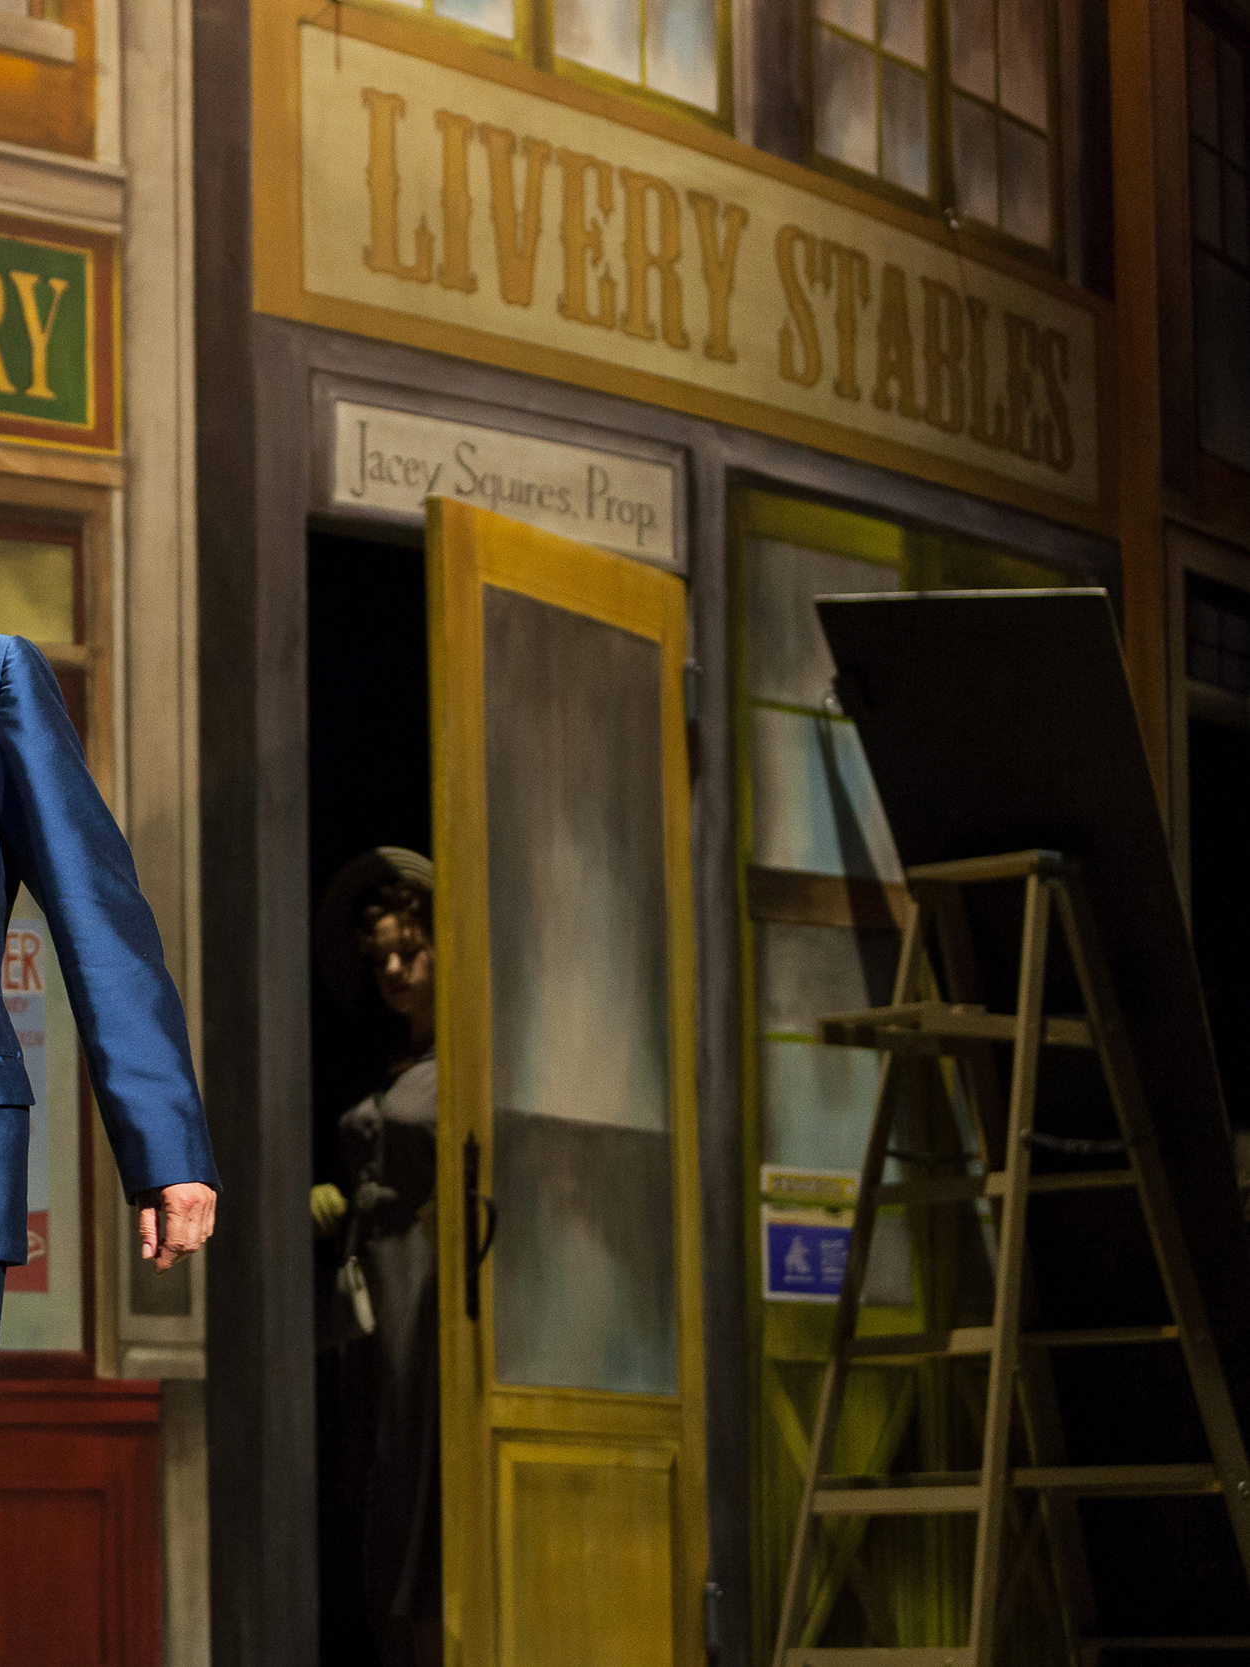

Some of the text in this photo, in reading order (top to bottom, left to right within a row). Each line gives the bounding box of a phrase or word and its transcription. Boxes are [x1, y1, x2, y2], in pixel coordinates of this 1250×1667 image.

[361, 87, 1076, 475] LIVERY STABLES
[348, 418, 442, 508] Jacey
